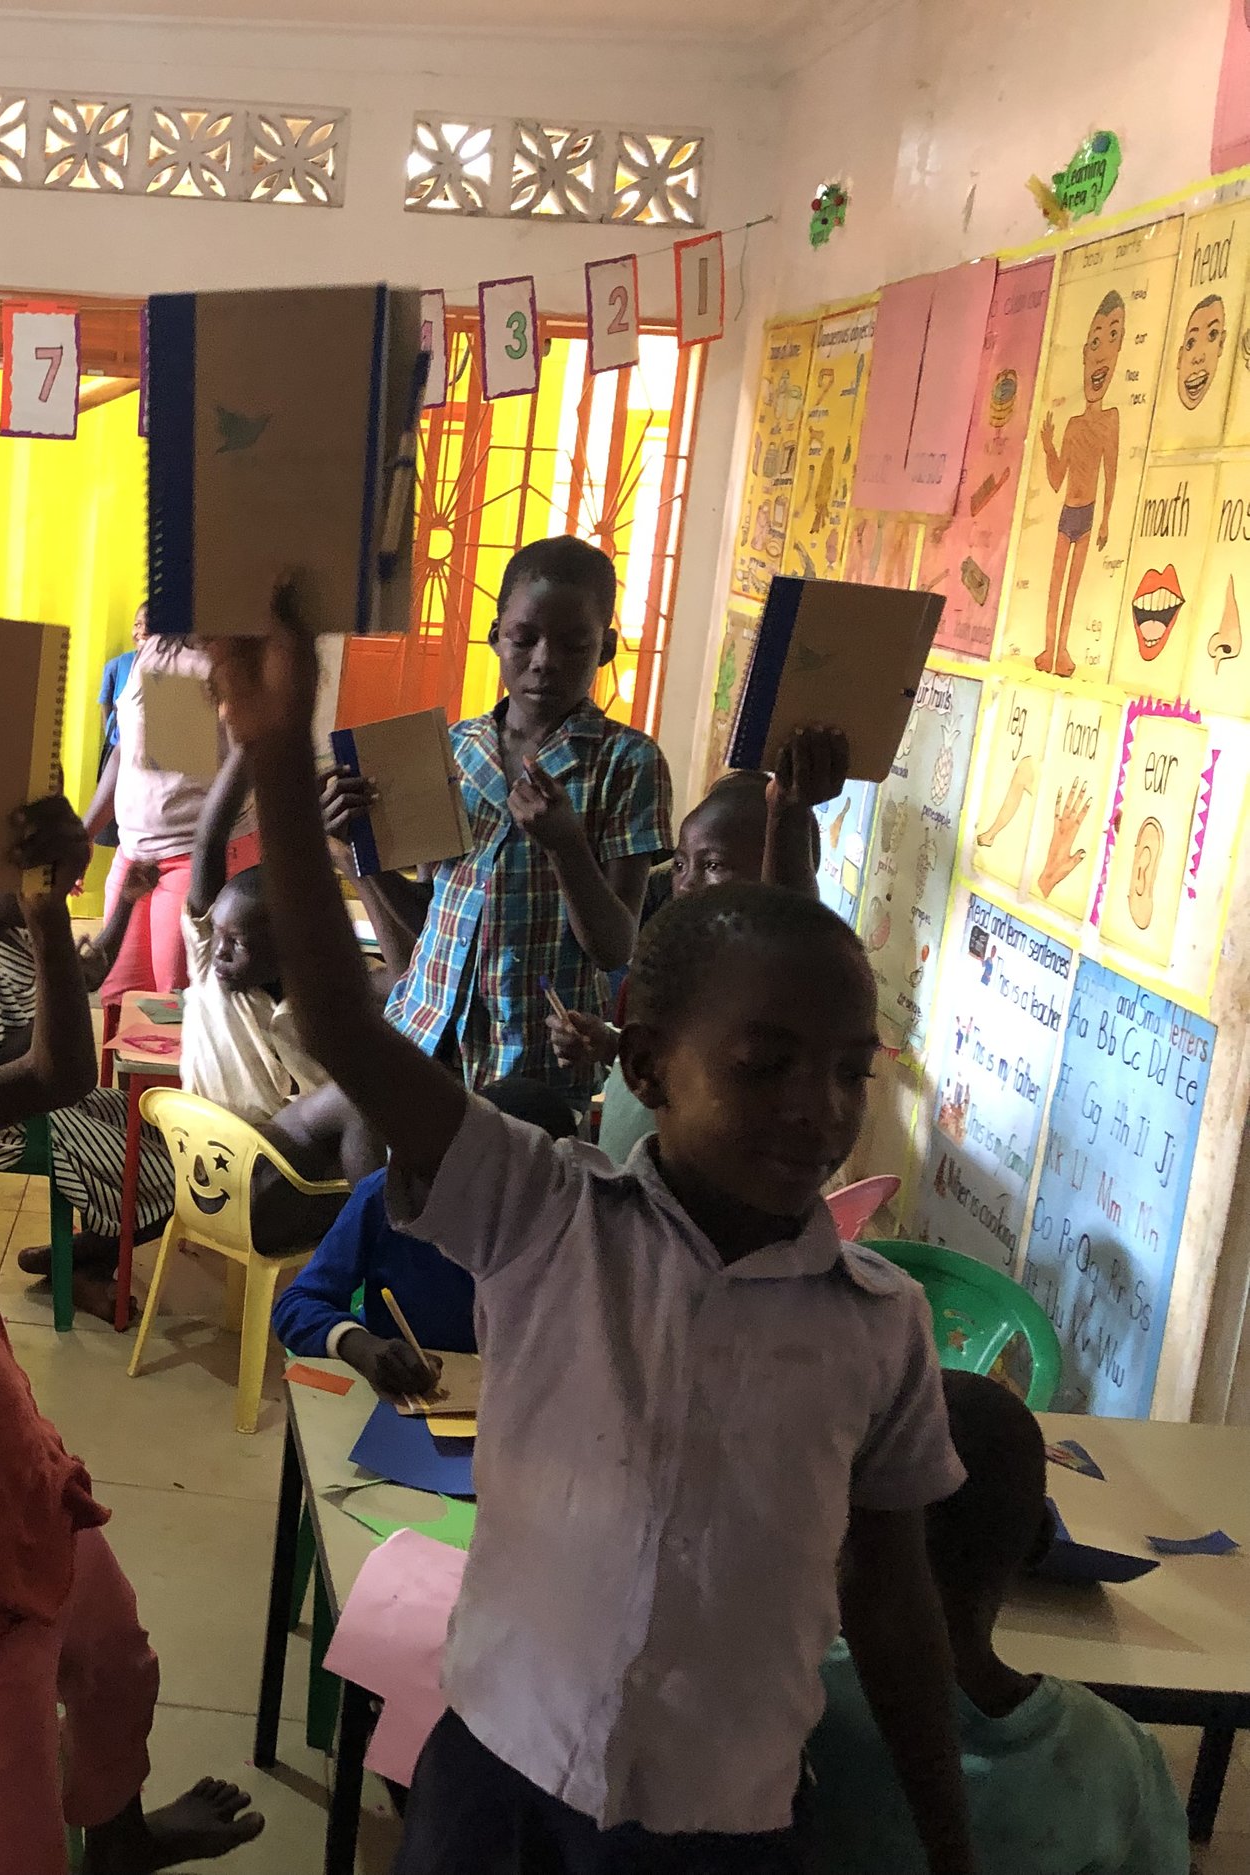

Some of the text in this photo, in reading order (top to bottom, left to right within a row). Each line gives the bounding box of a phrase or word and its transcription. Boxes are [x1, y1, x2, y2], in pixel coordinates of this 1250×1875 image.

[1065, 157, 1107, 193] Learning
[1061, 190, 1088, 211] Area
[1190, 220, 1235, 288] head
[607, 285, 630, 335] 2
[698, 257, 709, 316] 1
[504, 311, 528, 360] 3
[34, 344, 64, 404] 7
[1140, 481, 1190, 537] mouth
[1006, 690, 1102, 761] leg hand
[1144, 751, 1179, 795] ear
[1116, 984, 1141, 1021] and
